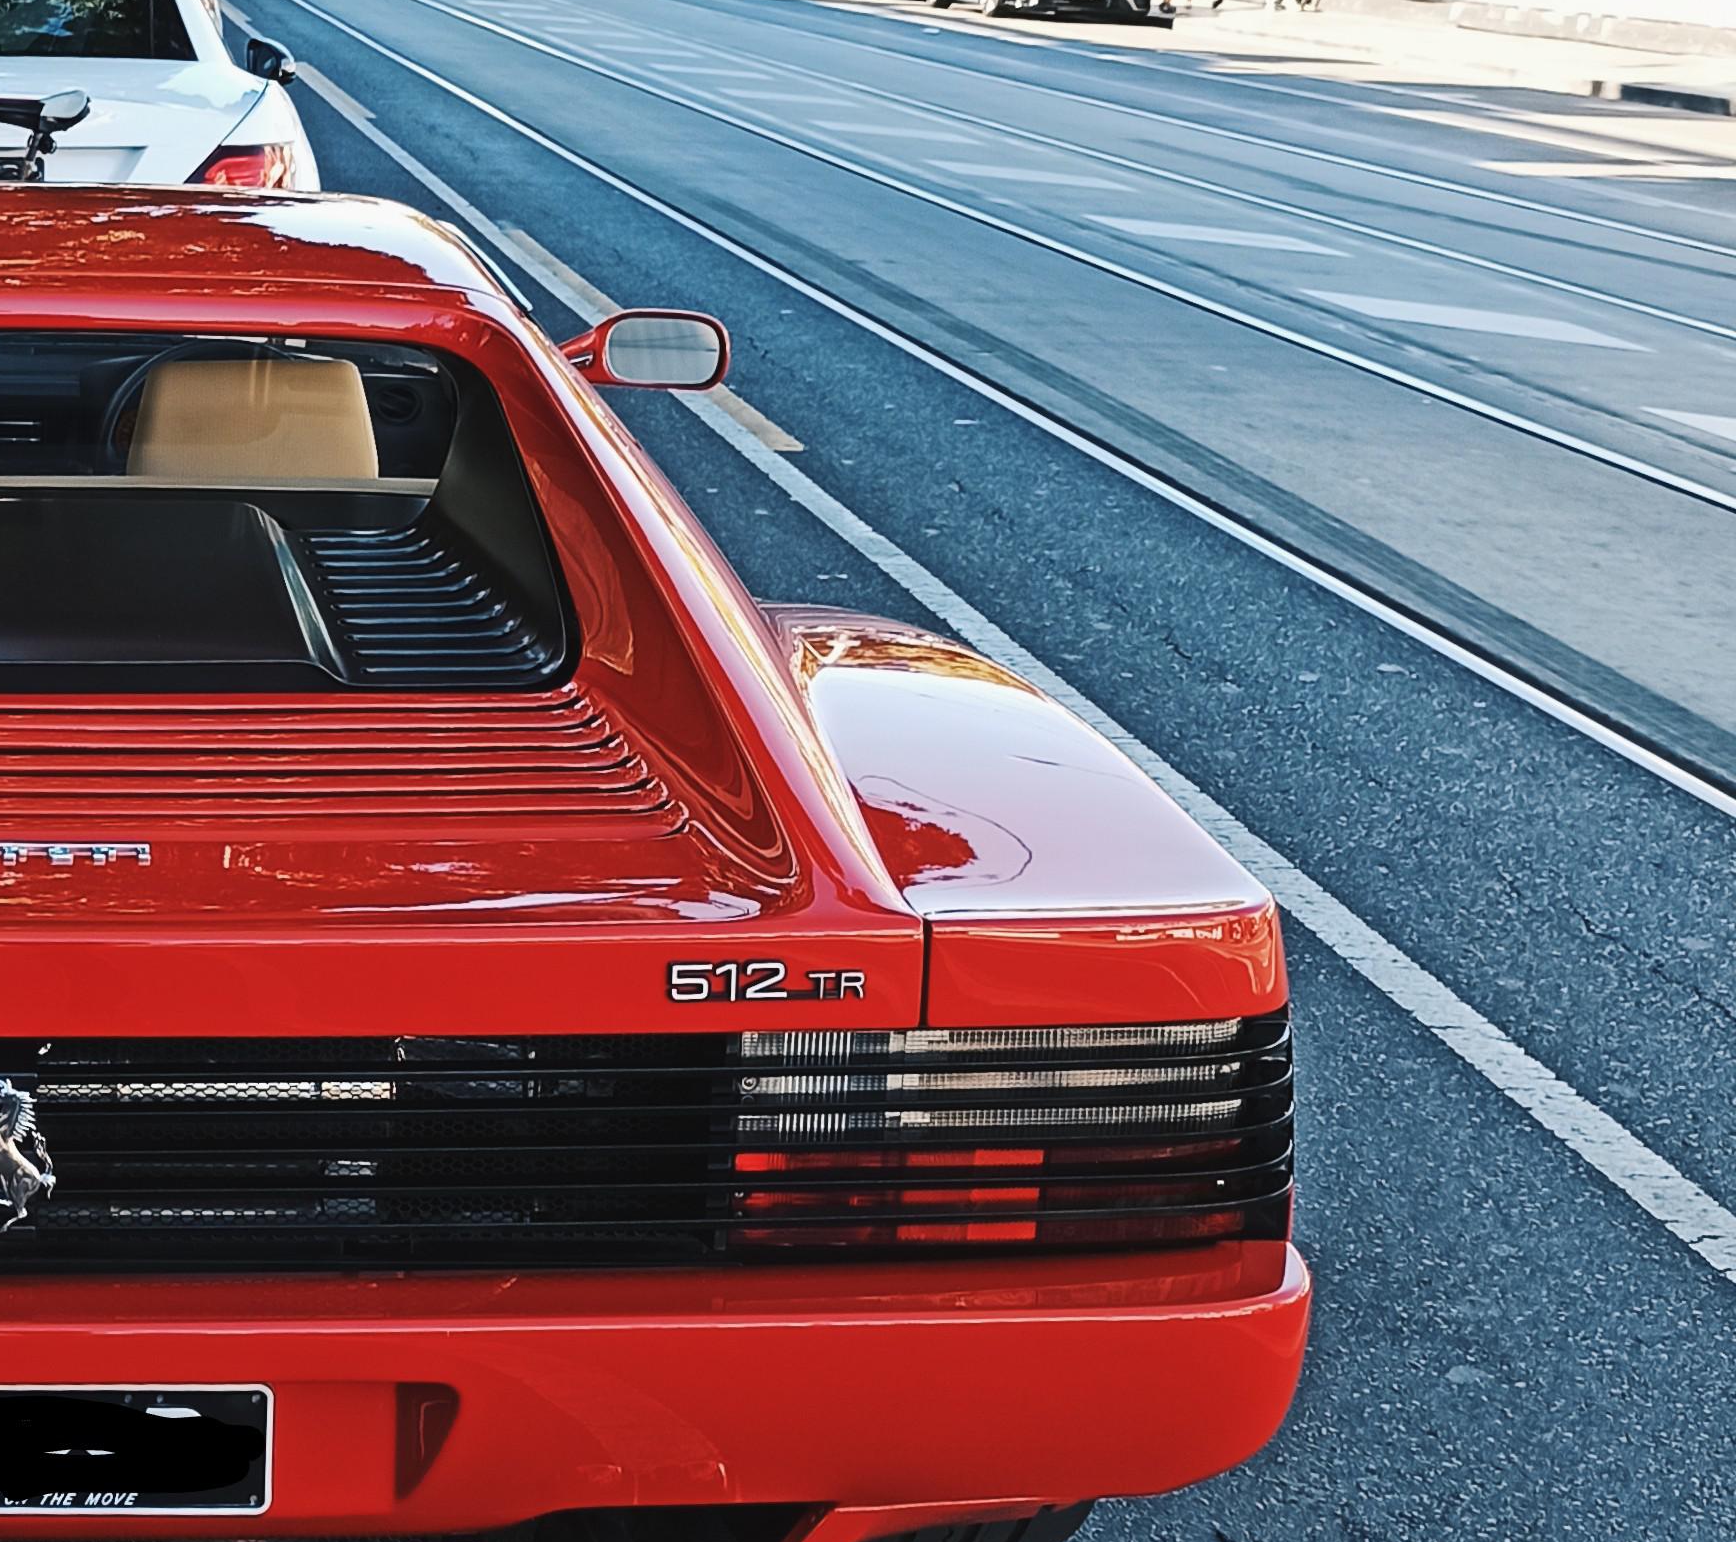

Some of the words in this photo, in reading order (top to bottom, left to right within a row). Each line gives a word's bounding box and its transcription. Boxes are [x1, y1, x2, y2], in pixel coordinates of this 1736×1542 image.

[669, 962, 788, 1002] 512
[808, 971, 864, 1000] TR
[40, 1493, 77, 1507] THE
[85, 1492, 138, 1507] MOVE
